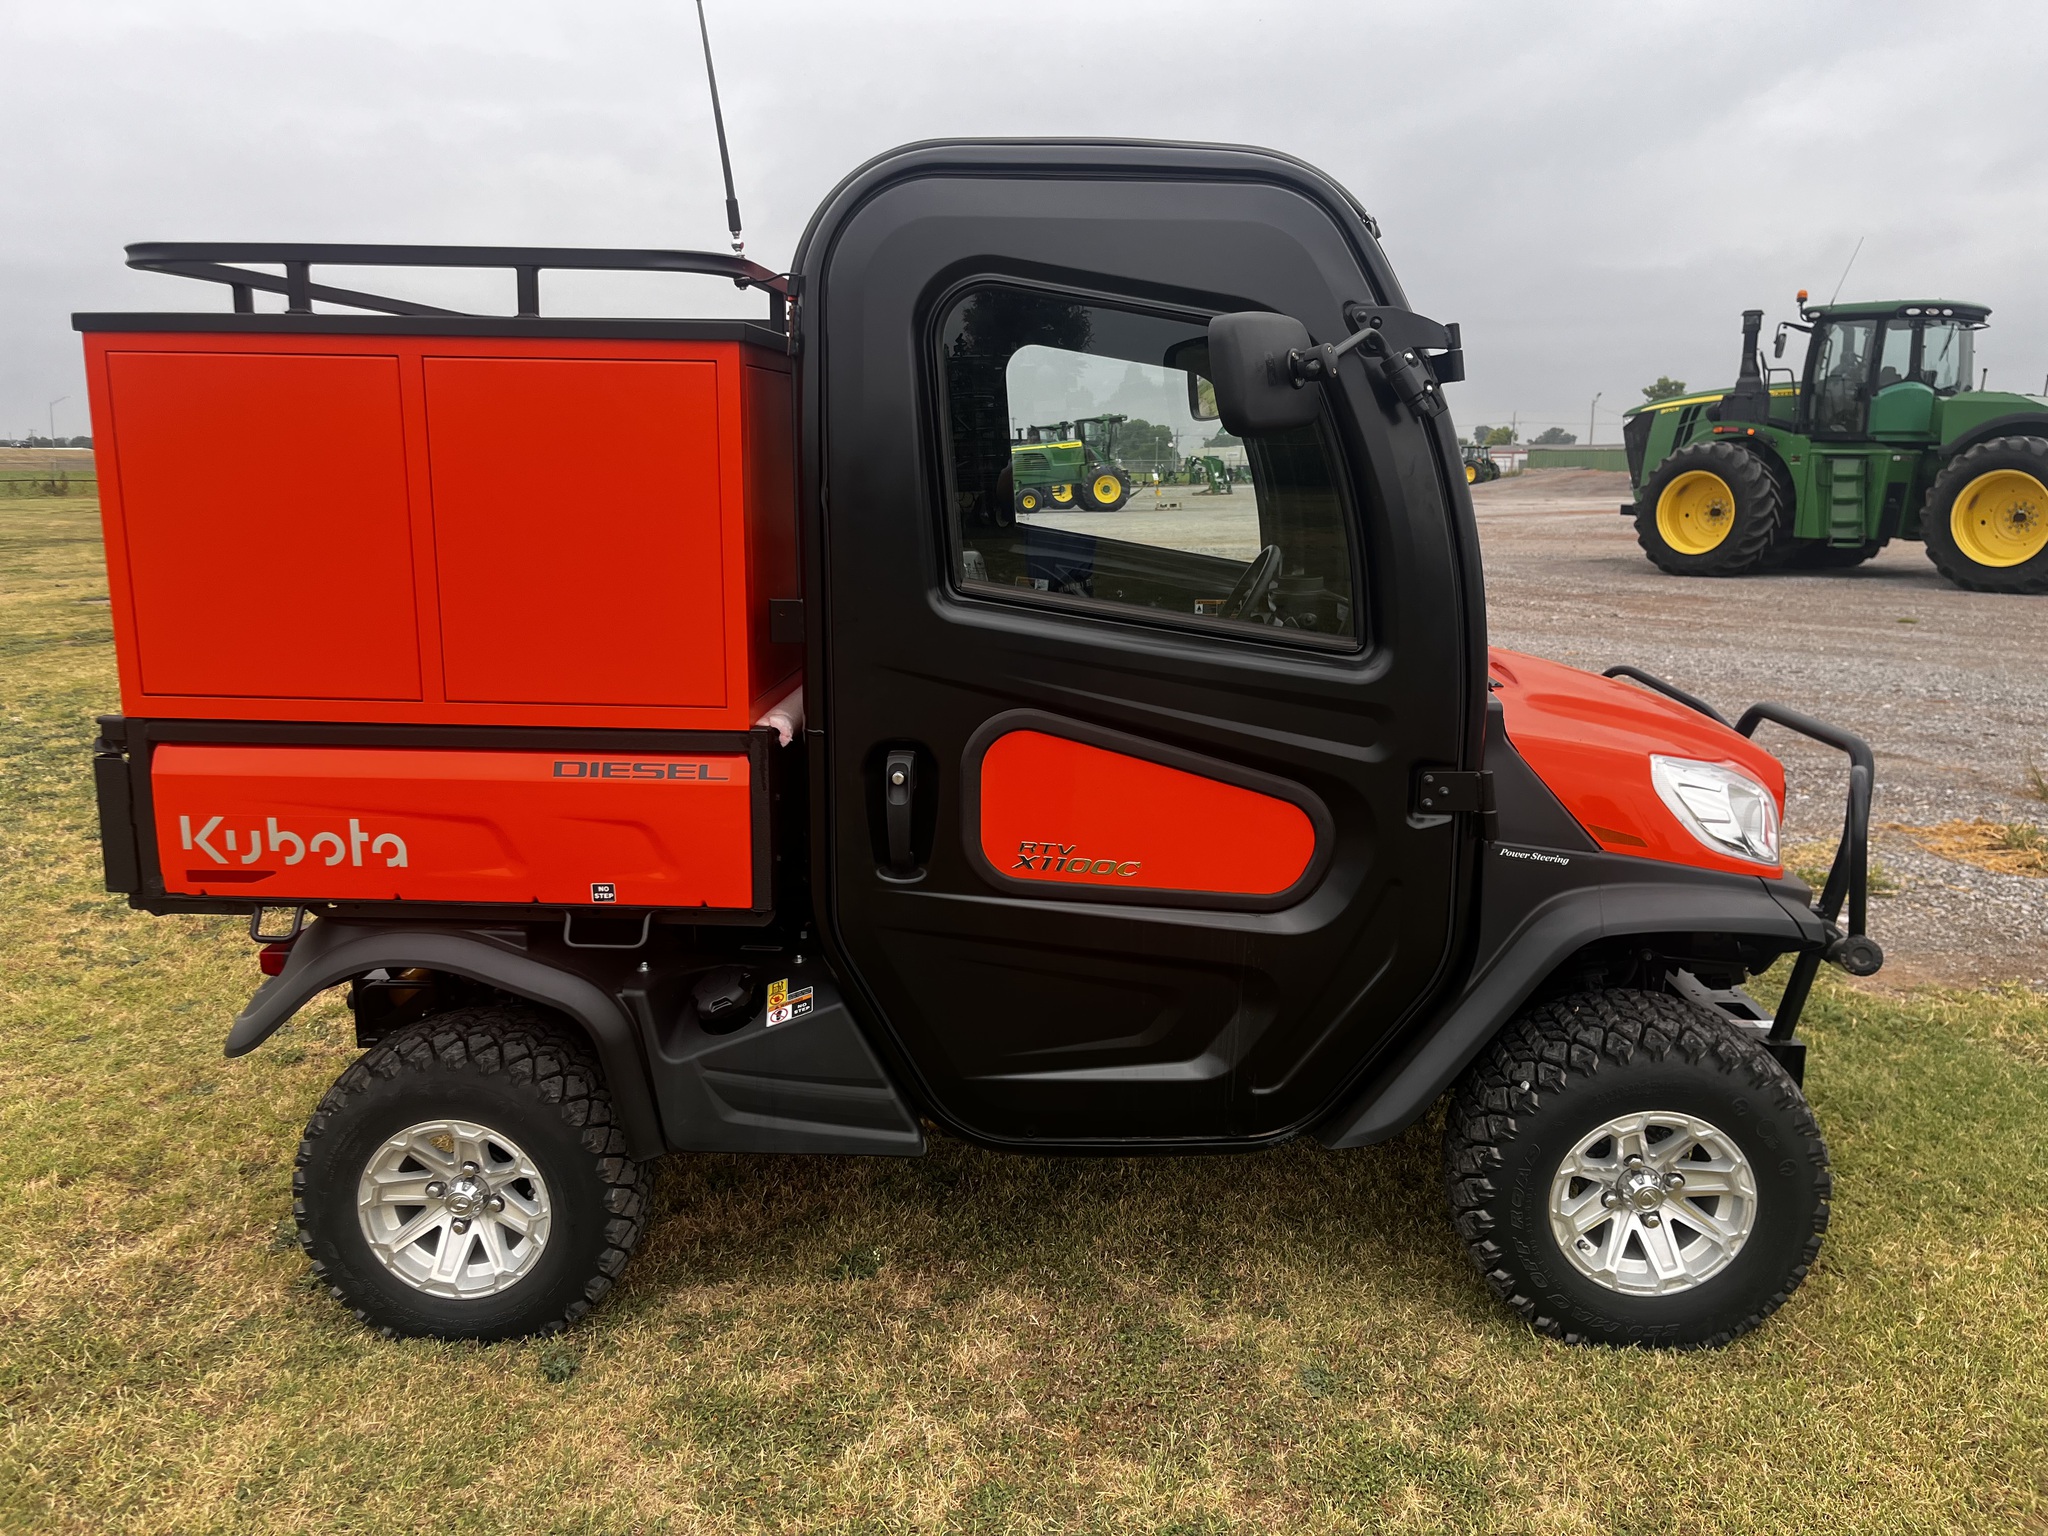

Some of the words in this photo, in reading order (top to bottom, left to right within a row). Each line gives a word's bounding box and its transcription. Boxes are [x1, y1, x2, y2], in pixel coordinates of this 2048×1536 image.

[553, 761, 729, 781] DIESEL
[179, 815, 408, 868] Kubota
[1019, 841, 1076, 855] RTV
[1011, 854, 1141, 877] X1100C
[1499, 848, 1530, 859] Power
[1530, 852, 1570, 866] Steering
[793, 1005, 810, 1014] STEP
[1509, 1142, 1541, 1230] ROAD
[1511, 1235, 1550, 1289] OFF
